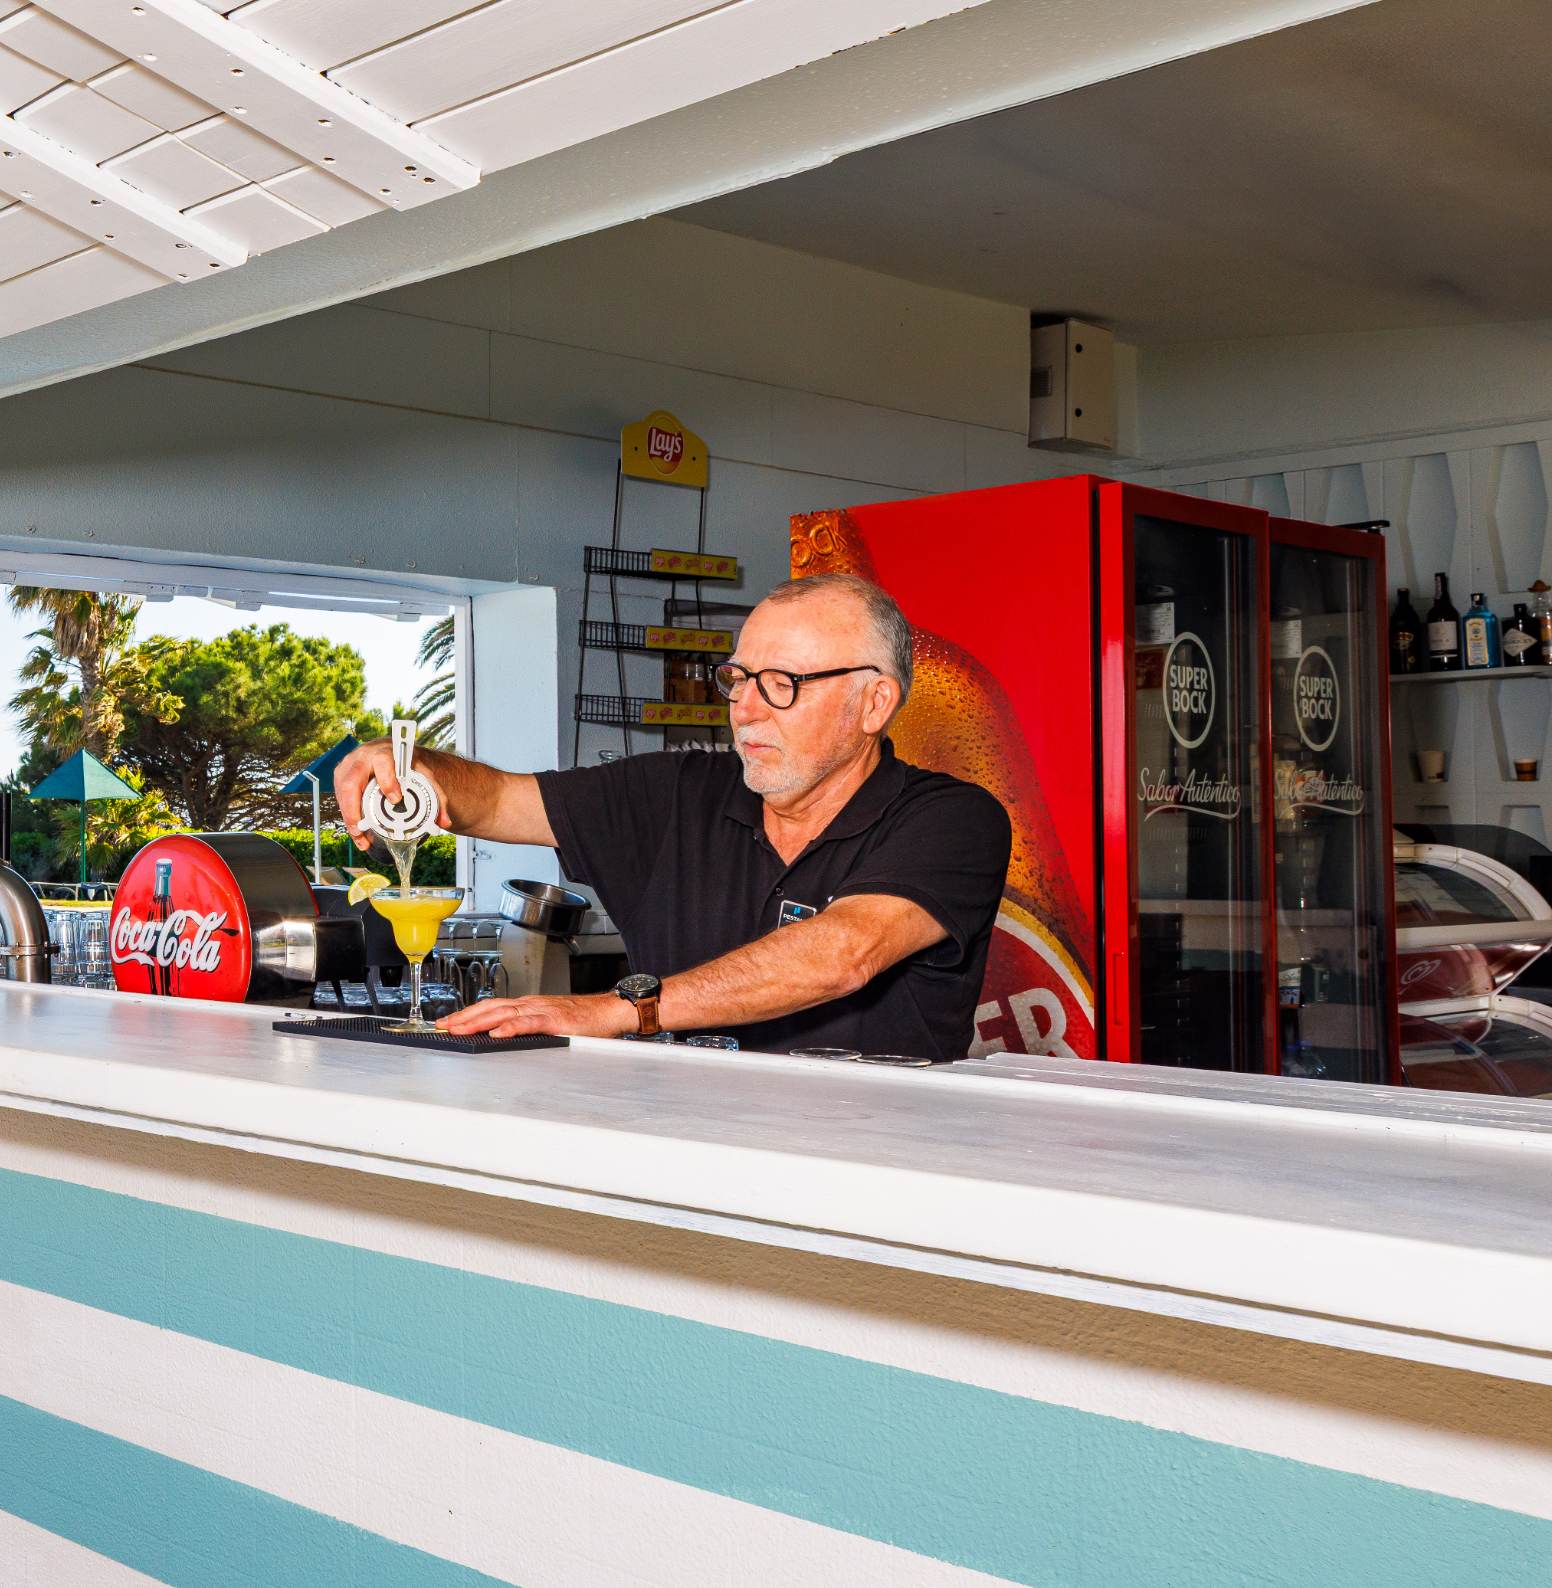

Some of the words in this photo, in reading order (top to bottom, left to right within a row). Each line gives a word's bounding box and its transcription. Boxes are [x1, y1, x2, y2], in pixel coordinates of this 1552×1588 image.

[650, 428, 682, 462] Lay's
[1169, 664, 1208, 690] SUPER
[1299, 675, 1334, 698] SUPER
[1172, 690, 1207, 714] BOCK
[1301, 698, 1333, 720] BOCK
[1137, 767, 1180, 802] Sabor
[111, 906, 227, 972] Coca-Cola
